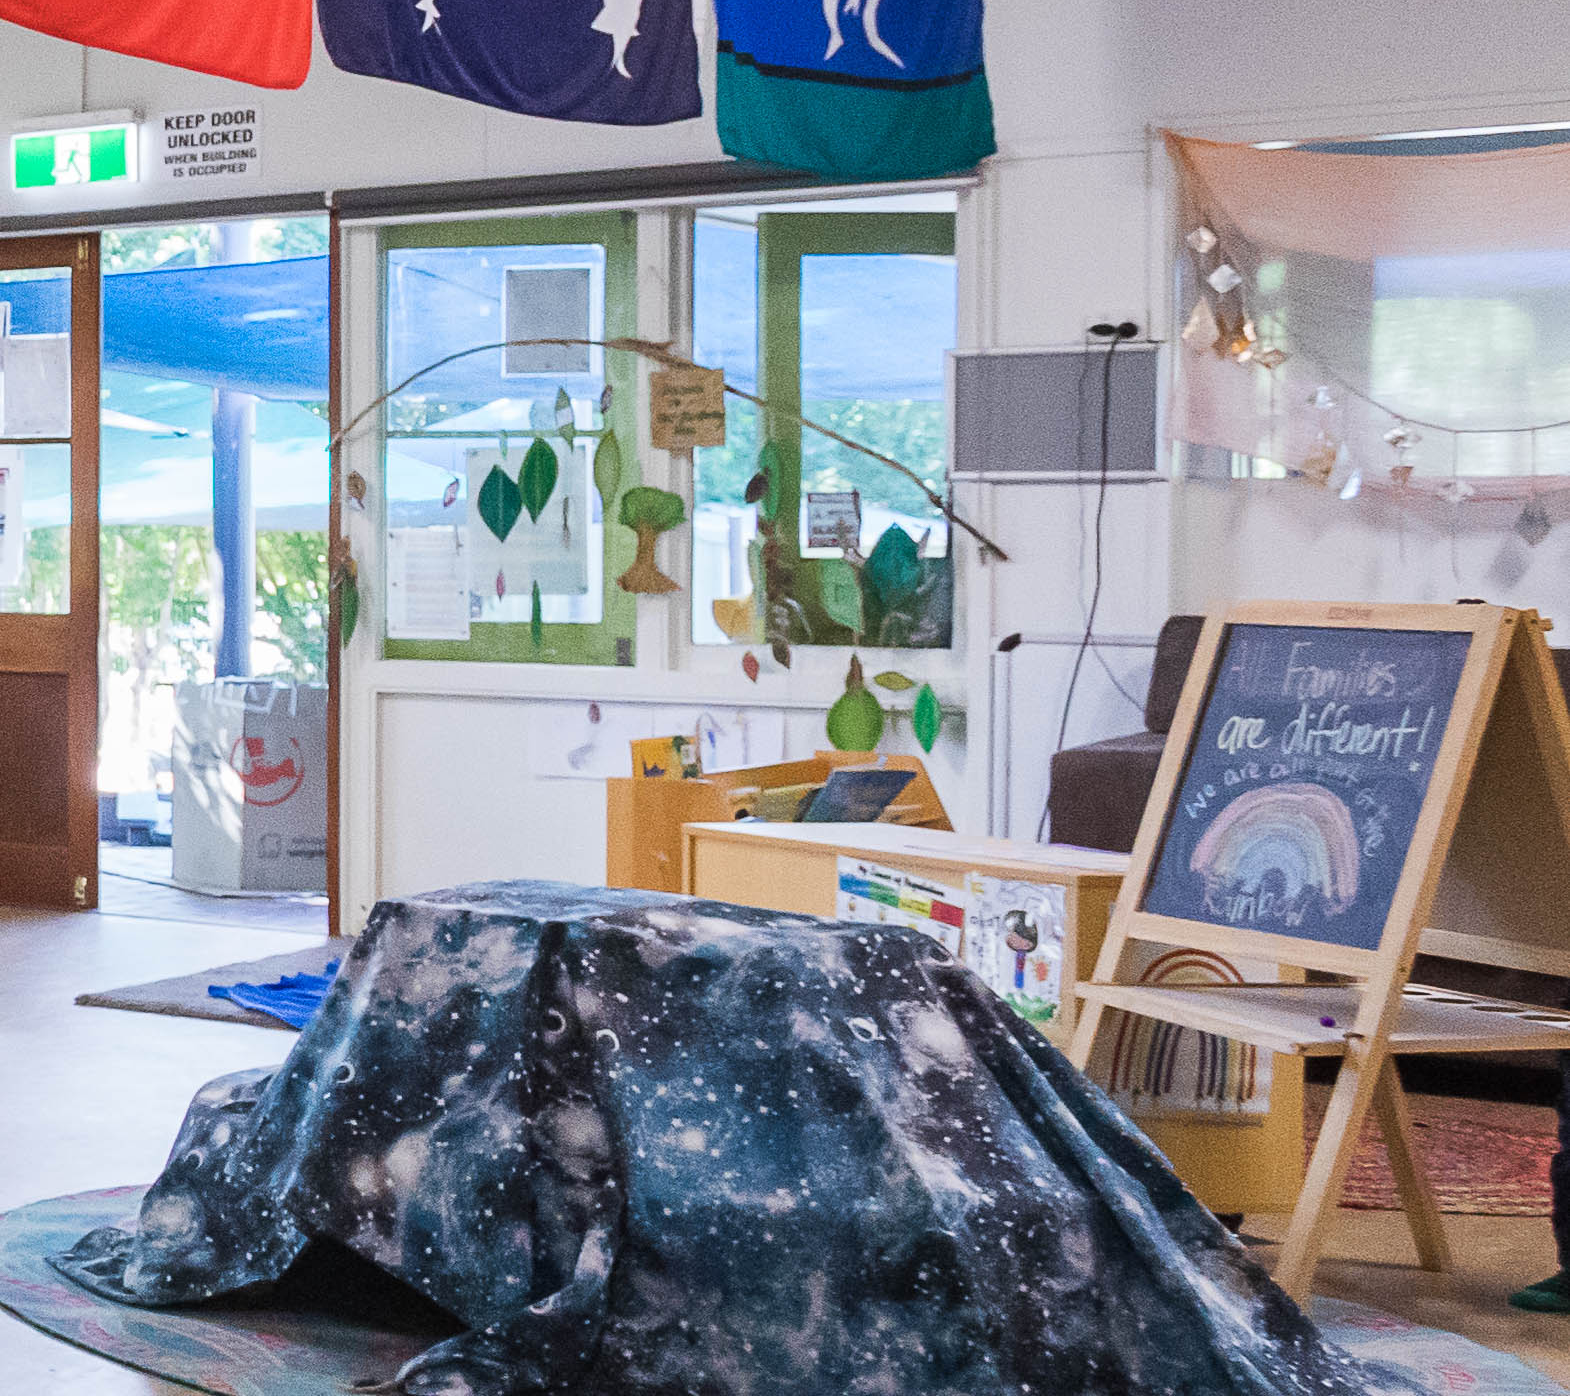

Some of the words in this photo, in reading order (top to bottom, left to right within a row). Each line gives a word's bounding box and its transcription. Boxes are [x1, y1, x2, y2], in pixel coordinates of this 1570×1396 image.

[164, 114, 205, 131] KEEP
[211, 109, 256, 127] DOOR
[168, 128, 254, 149] UNLOCKED
[164, 153, 198, 165] WHEN
[202, 147, 257, 162] BUILDING
[173, 167, 185, 178] IS
[188, 162, 247, 177] OCCUPIED
[1217, 715, 1271, 755] are
